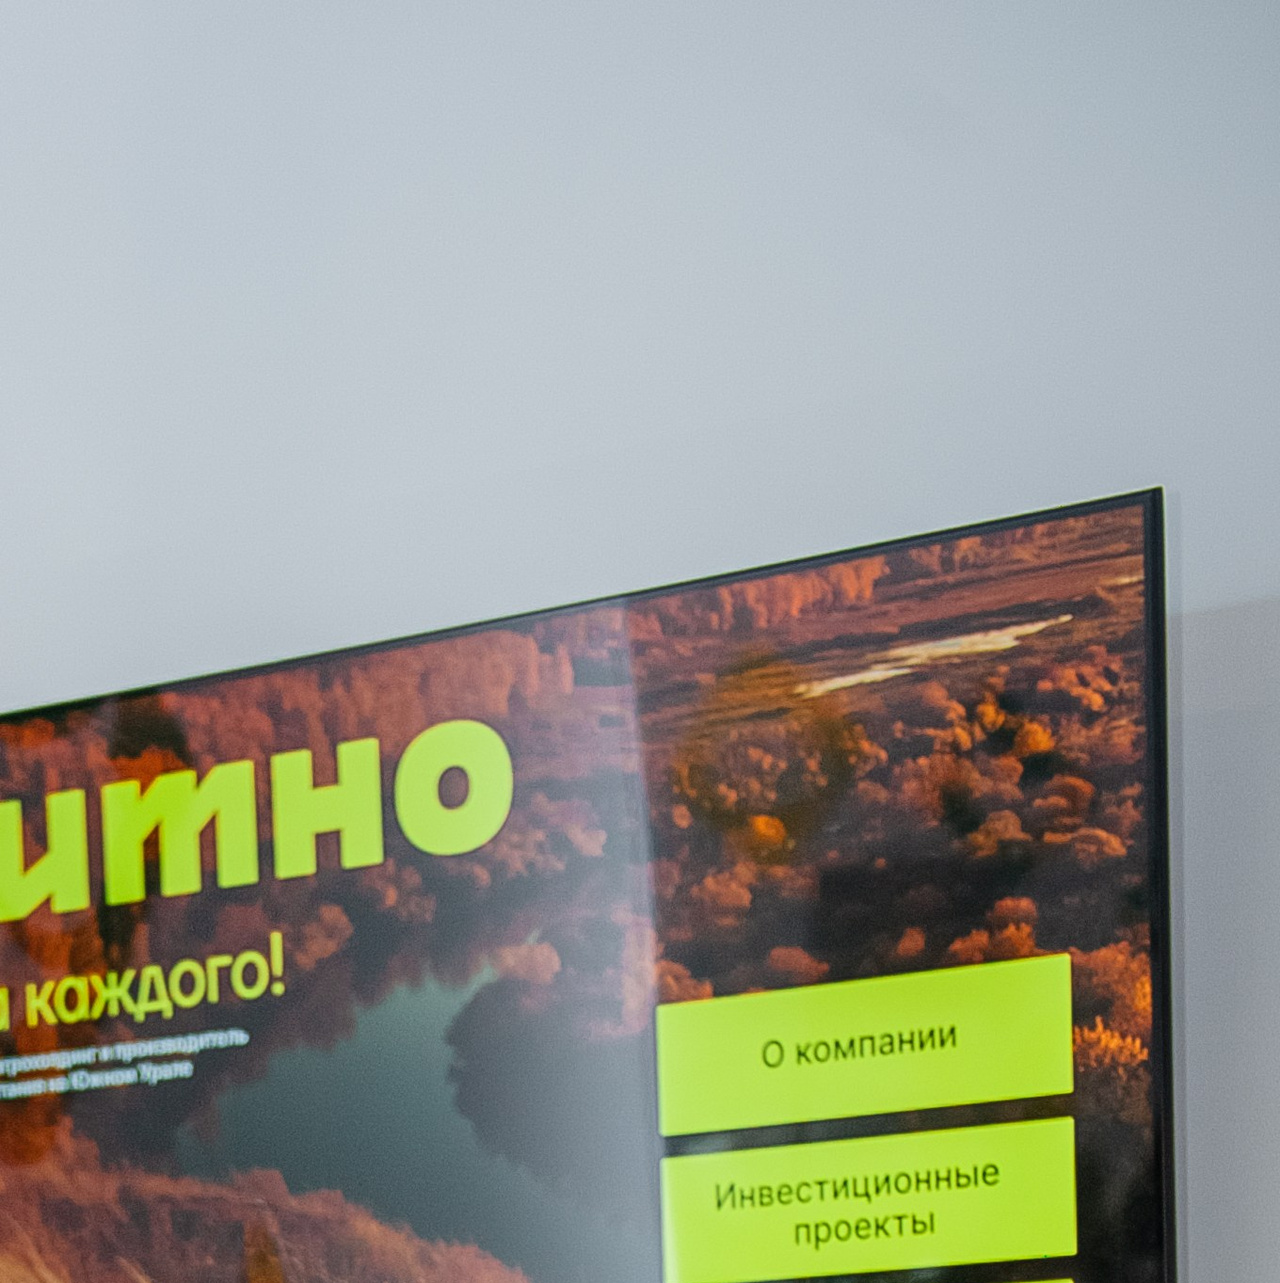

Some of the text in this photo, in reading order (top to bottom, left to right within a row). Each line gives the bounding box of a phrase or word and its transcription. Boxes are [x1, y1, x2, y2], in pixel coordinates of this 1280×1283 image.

[26, 931, 286, 1028] каждого!
[761, 1024, 958, 1069] О компании
[715, 1160, 1001, 1212] Инвестиционные
[794, 1210, 936, 1251] проекты
